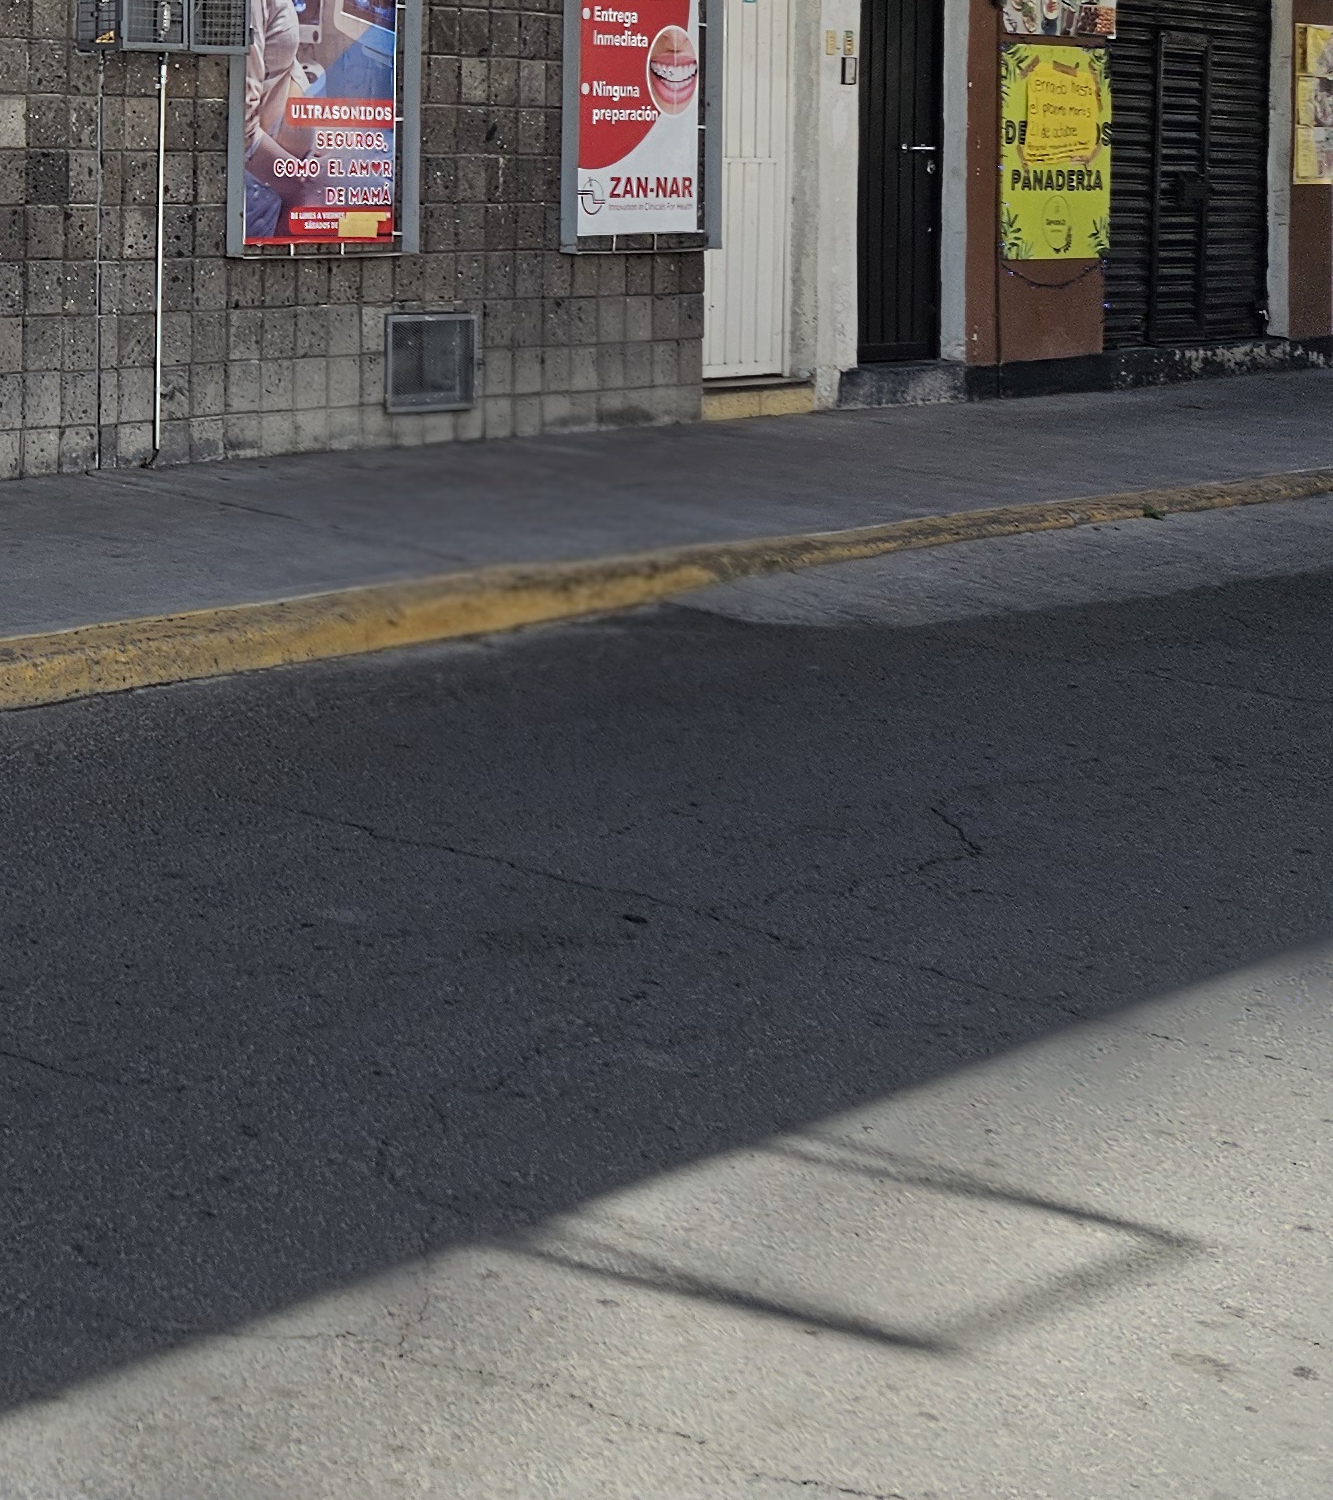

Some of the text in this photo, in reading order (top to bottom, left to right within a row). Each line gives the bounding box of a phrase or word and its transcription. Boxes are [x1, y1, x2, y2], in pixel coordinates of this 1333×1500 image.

[593, 6, 639, 27] Entrega
[592, 30, 649, 48] Inmediata
[592, 81, 640, 101] Ninguna
[291, 104, 393, 122] ULTRASONIDOS
[592, 106, 660, 124] preparación
[273, 158, 320, 178] COMO
[327, 159, 344, 177] EL
[609, 176, 693, 198] ZAN-NAR
[1010, 168, 1104, 192] PANADERIA
[325, 182, 392, 205] DE MAMÁ
